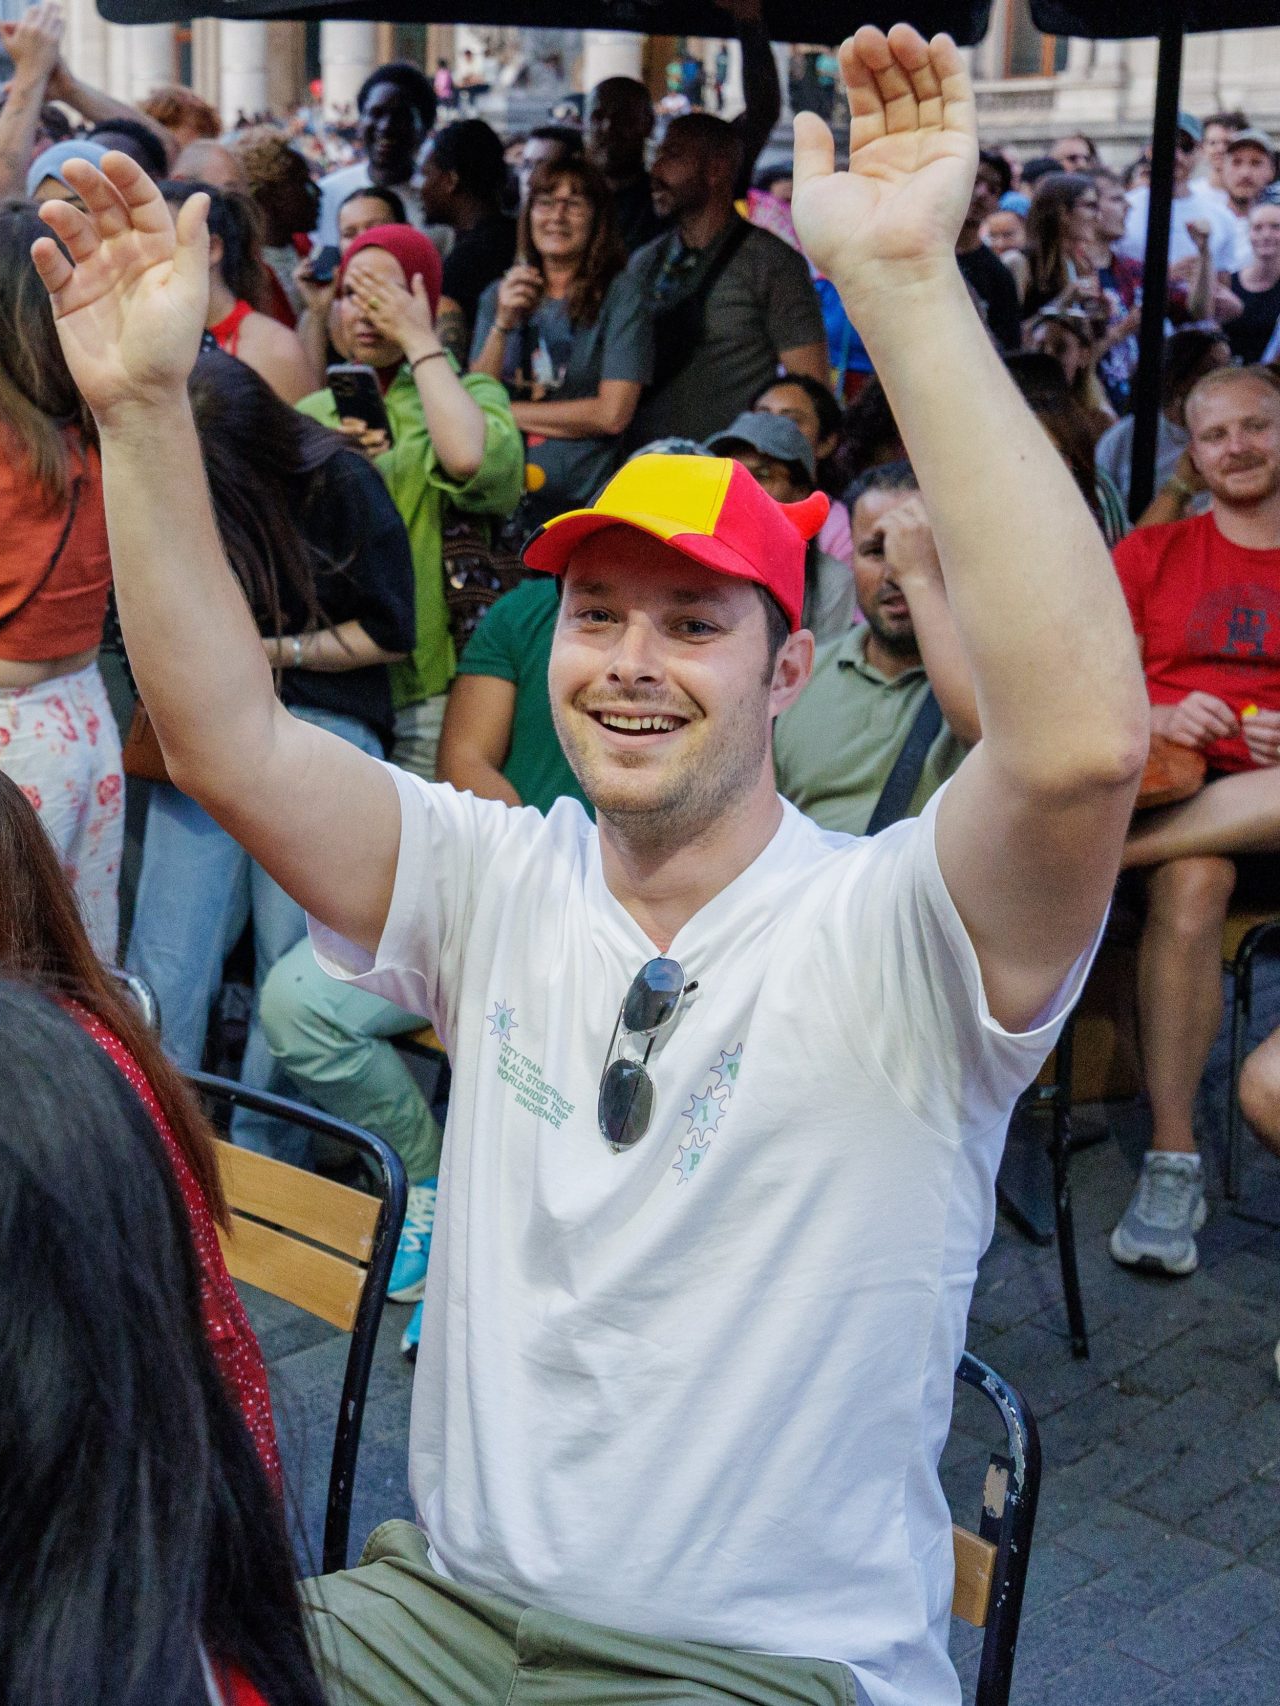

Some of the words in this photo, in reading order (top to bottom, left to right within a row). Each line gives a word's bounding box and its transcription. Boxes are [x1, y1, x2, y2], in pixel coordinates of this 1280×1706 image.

[501, 1042, 521, 1058] CITY
[509, 1063, 525, 1079] ALL
[550, 1101, 569, 1121] TRIP
